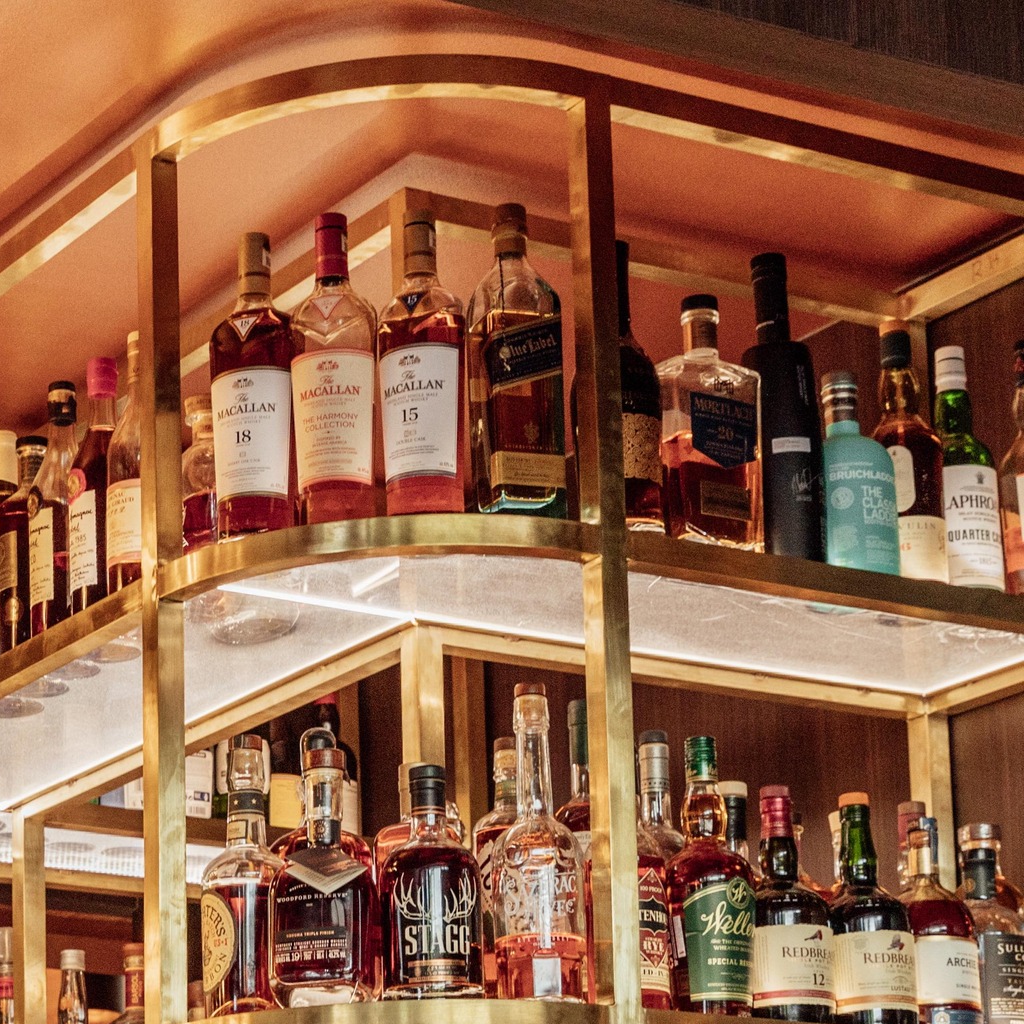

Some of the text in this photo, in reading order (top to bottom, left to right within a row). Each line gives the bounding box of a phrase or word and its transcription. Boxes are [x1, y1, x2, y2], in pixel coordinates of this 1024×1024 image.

[405, 293, 418, 305] 15
[319, 375, 335, 386] The
[400, 370, 416, 382] The
[299, 386, 360, 402] MACALLAN
[384, 379, 445, 400] MACALLAN
[235, 393, 250, 404] The
[217, 402, 276, 422] MACALLAN
[401, 407, 419, 423] 15
[693, 397, 755, 420] MORTLACH
[316, 413, 359, 424] HARMONY
[304, 421, 355, 433] COLLECTION
[235, 429, 251, 445] 18
[861, 485, 883, 498] THE
[948, 528, 991, 542] QUARTER
[276, 893, 313, 904] WOODFORD
[638, 909, 667, 925] TENHO
[404, 924, 470, 956] STAGG
[996, 943, 1024, 955] SULL
[707, 957, 739, 966] SPECIAL
[812, 972, 826, 986] 12
